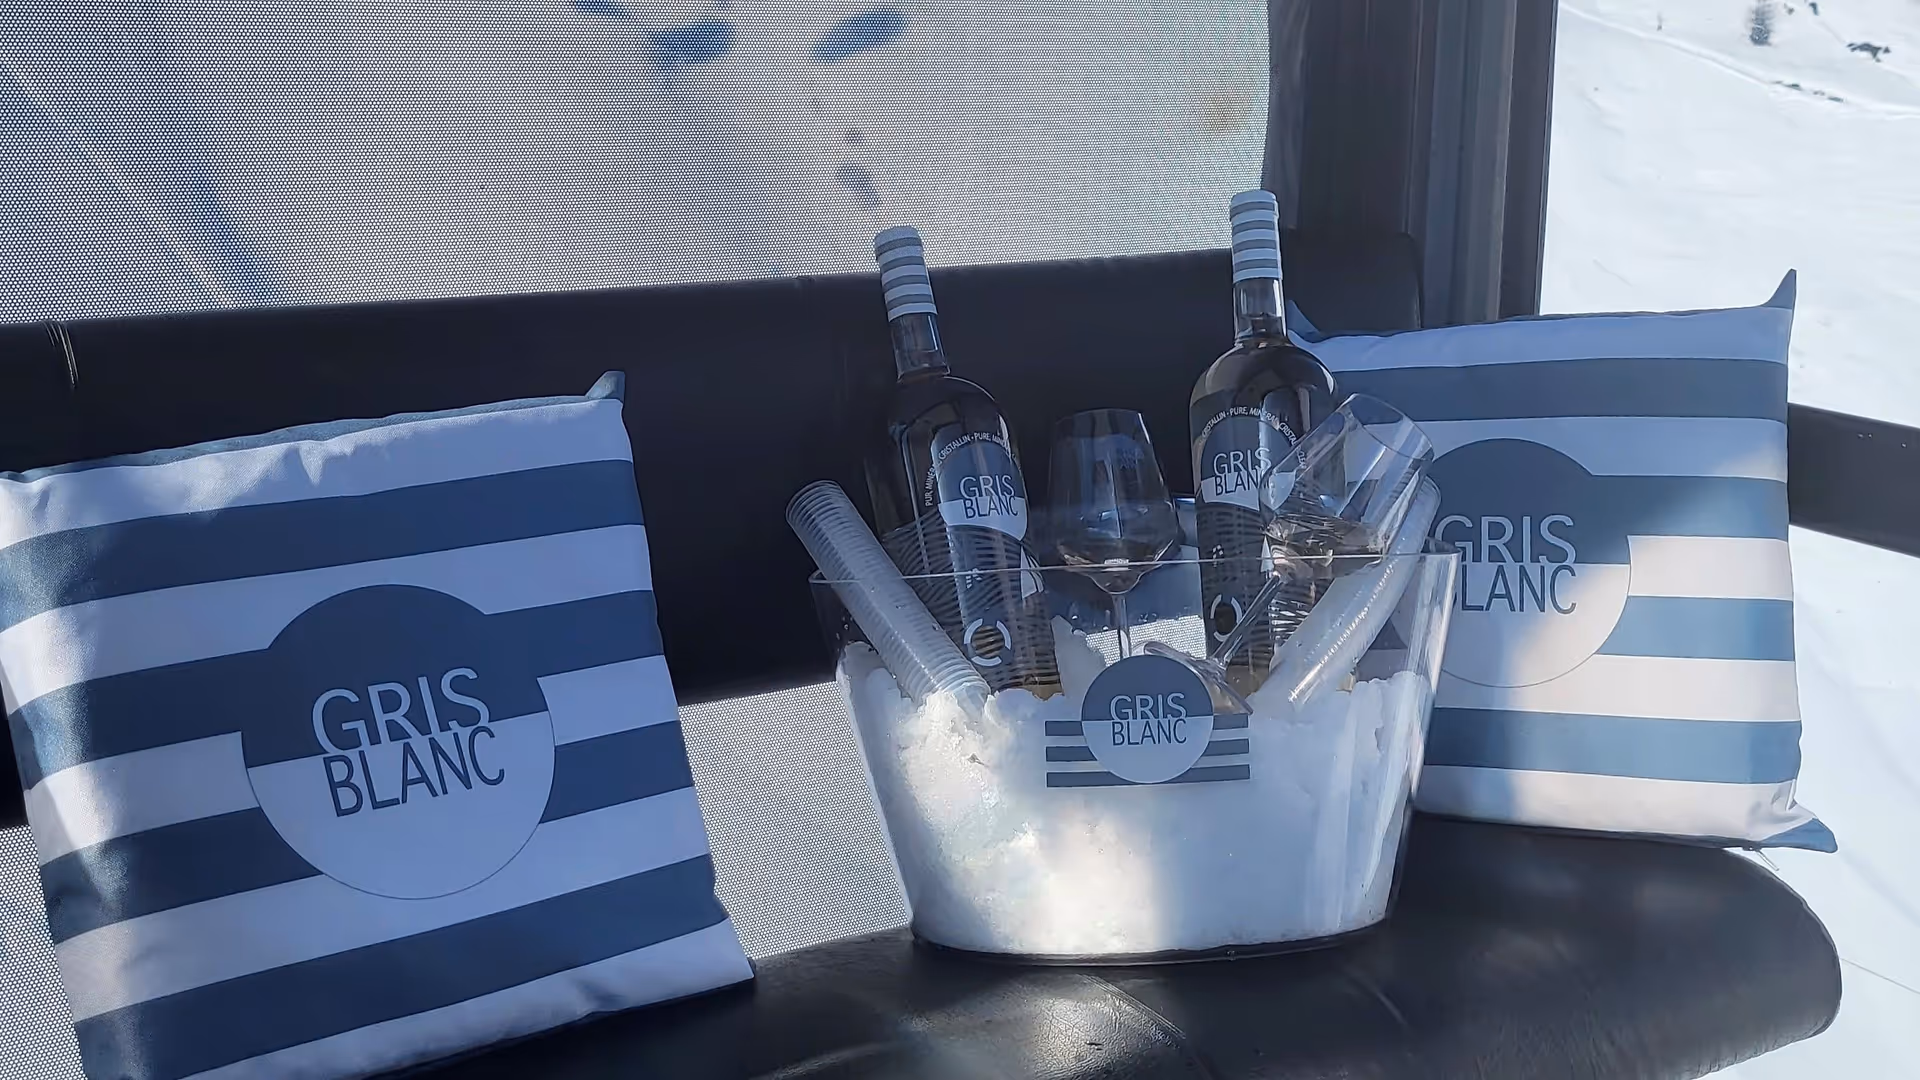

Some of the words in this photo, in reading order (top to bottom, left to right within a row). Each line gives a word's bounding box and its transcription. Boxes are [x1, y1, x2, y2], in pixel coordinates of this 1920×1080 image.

[938, 433, 971, 460] CRISTALLIN
[1213, 447, 1272, 477] GRIS
[959, 474, 1015, 499] GRIS
[1214, 470, 1260, 497] BLAN
[962, 496, 1019, 519] BLANC
[1434, 514, 1577, 565] GRIS
[1453, 564, 1577, 616] LANC
[311, 666, 491, 754] GRIS
[1110, 692, 1187, 721] GRIS
[1111, 718, 1188, 746] BLANC
[322, 725, 505, 818] BLANC
